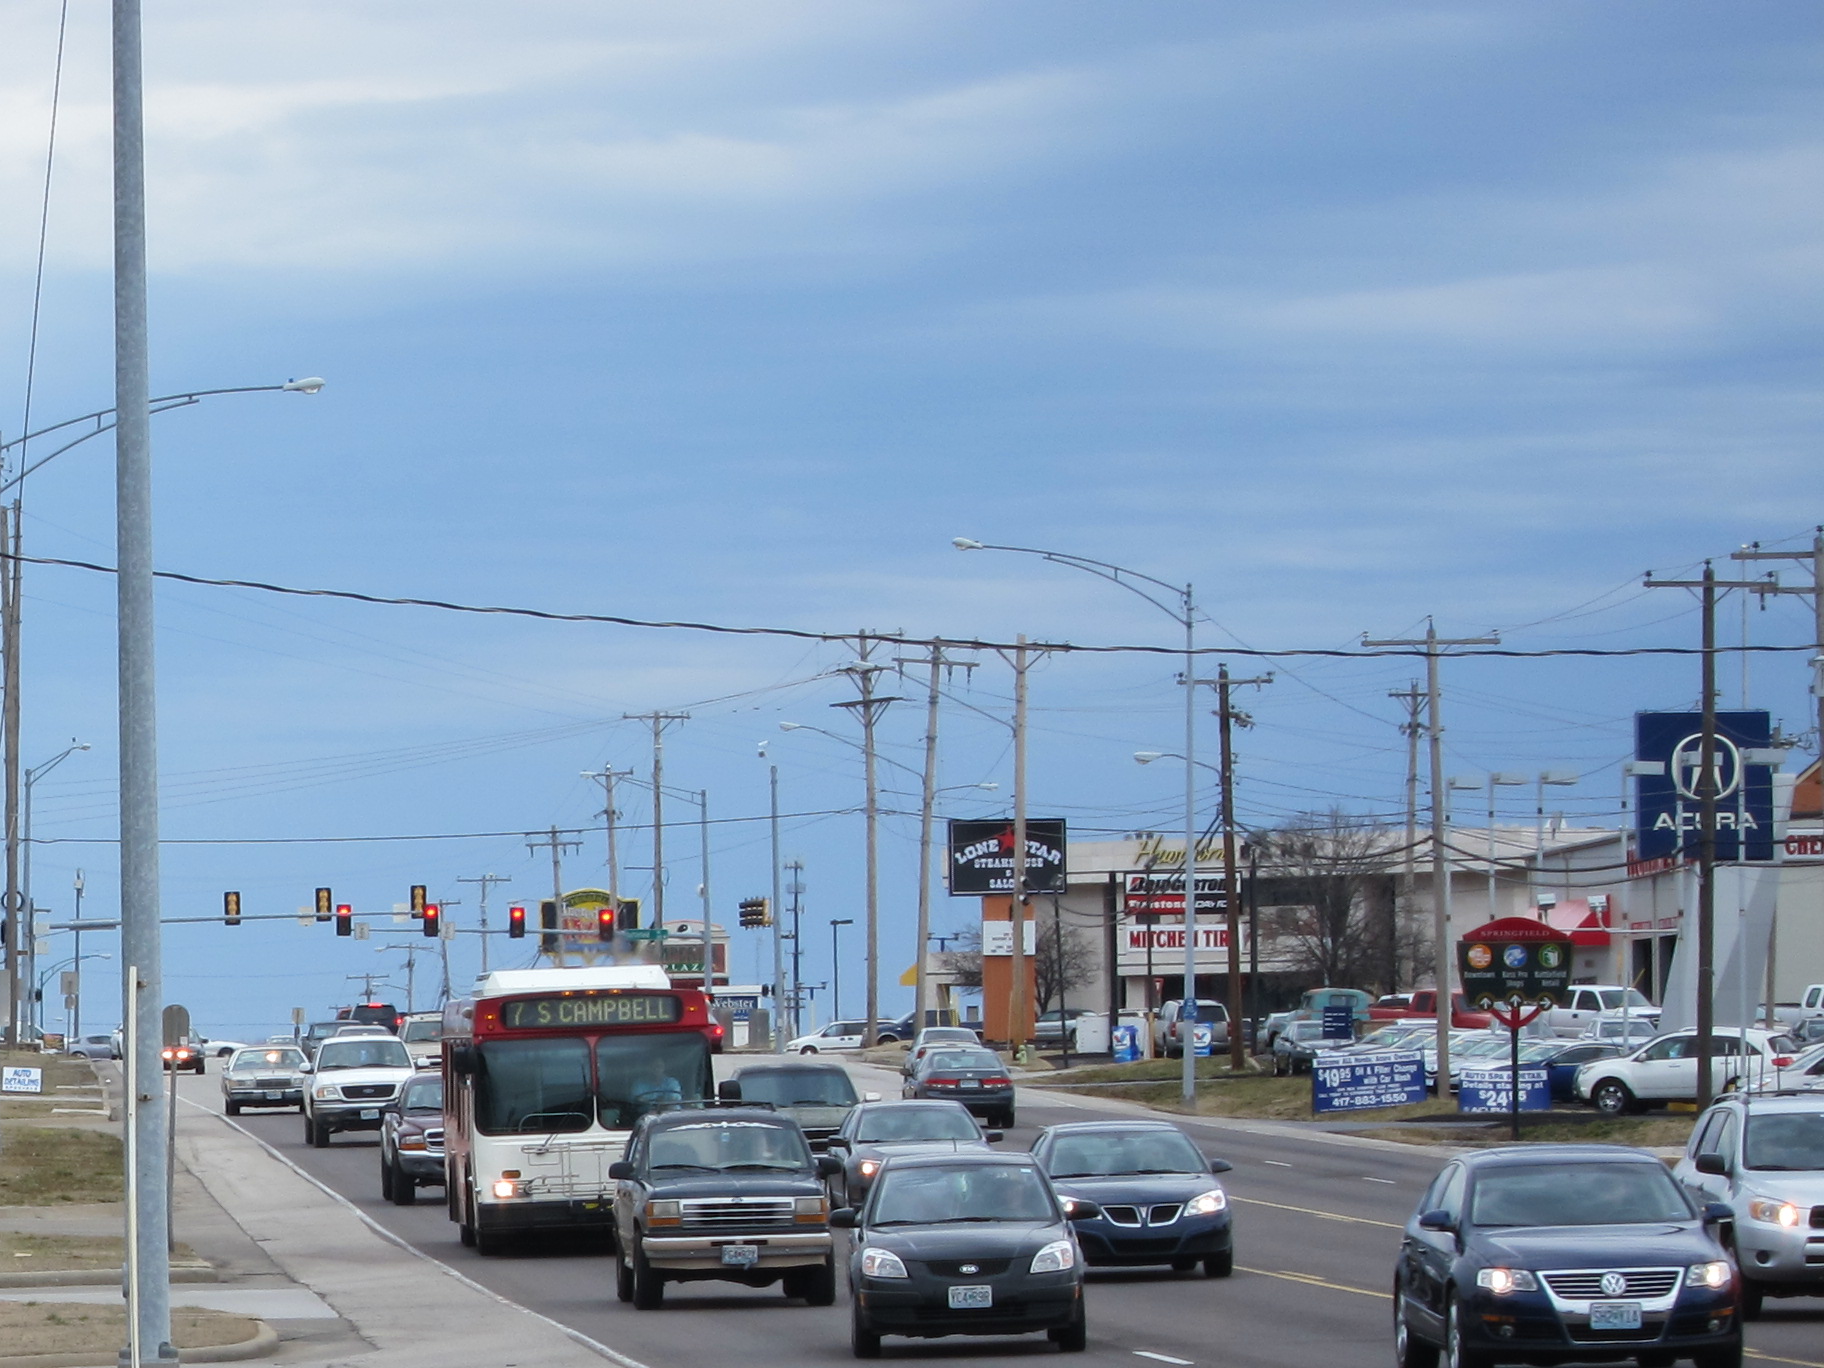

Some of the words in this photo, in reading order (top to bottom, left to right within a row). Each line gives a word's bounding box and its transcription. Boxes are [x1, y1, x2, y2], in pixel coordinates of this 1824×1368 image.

[955, 839, 999, 864] LONE
[1203, 929, 1230, 947] TIR
[510, 1003, 523, 1026] 7
[538, 1003, 551, 1023] S
[559, 998, 670, 1022] CAMPBELL
[12, 1069, 32, 1077] AUTO
